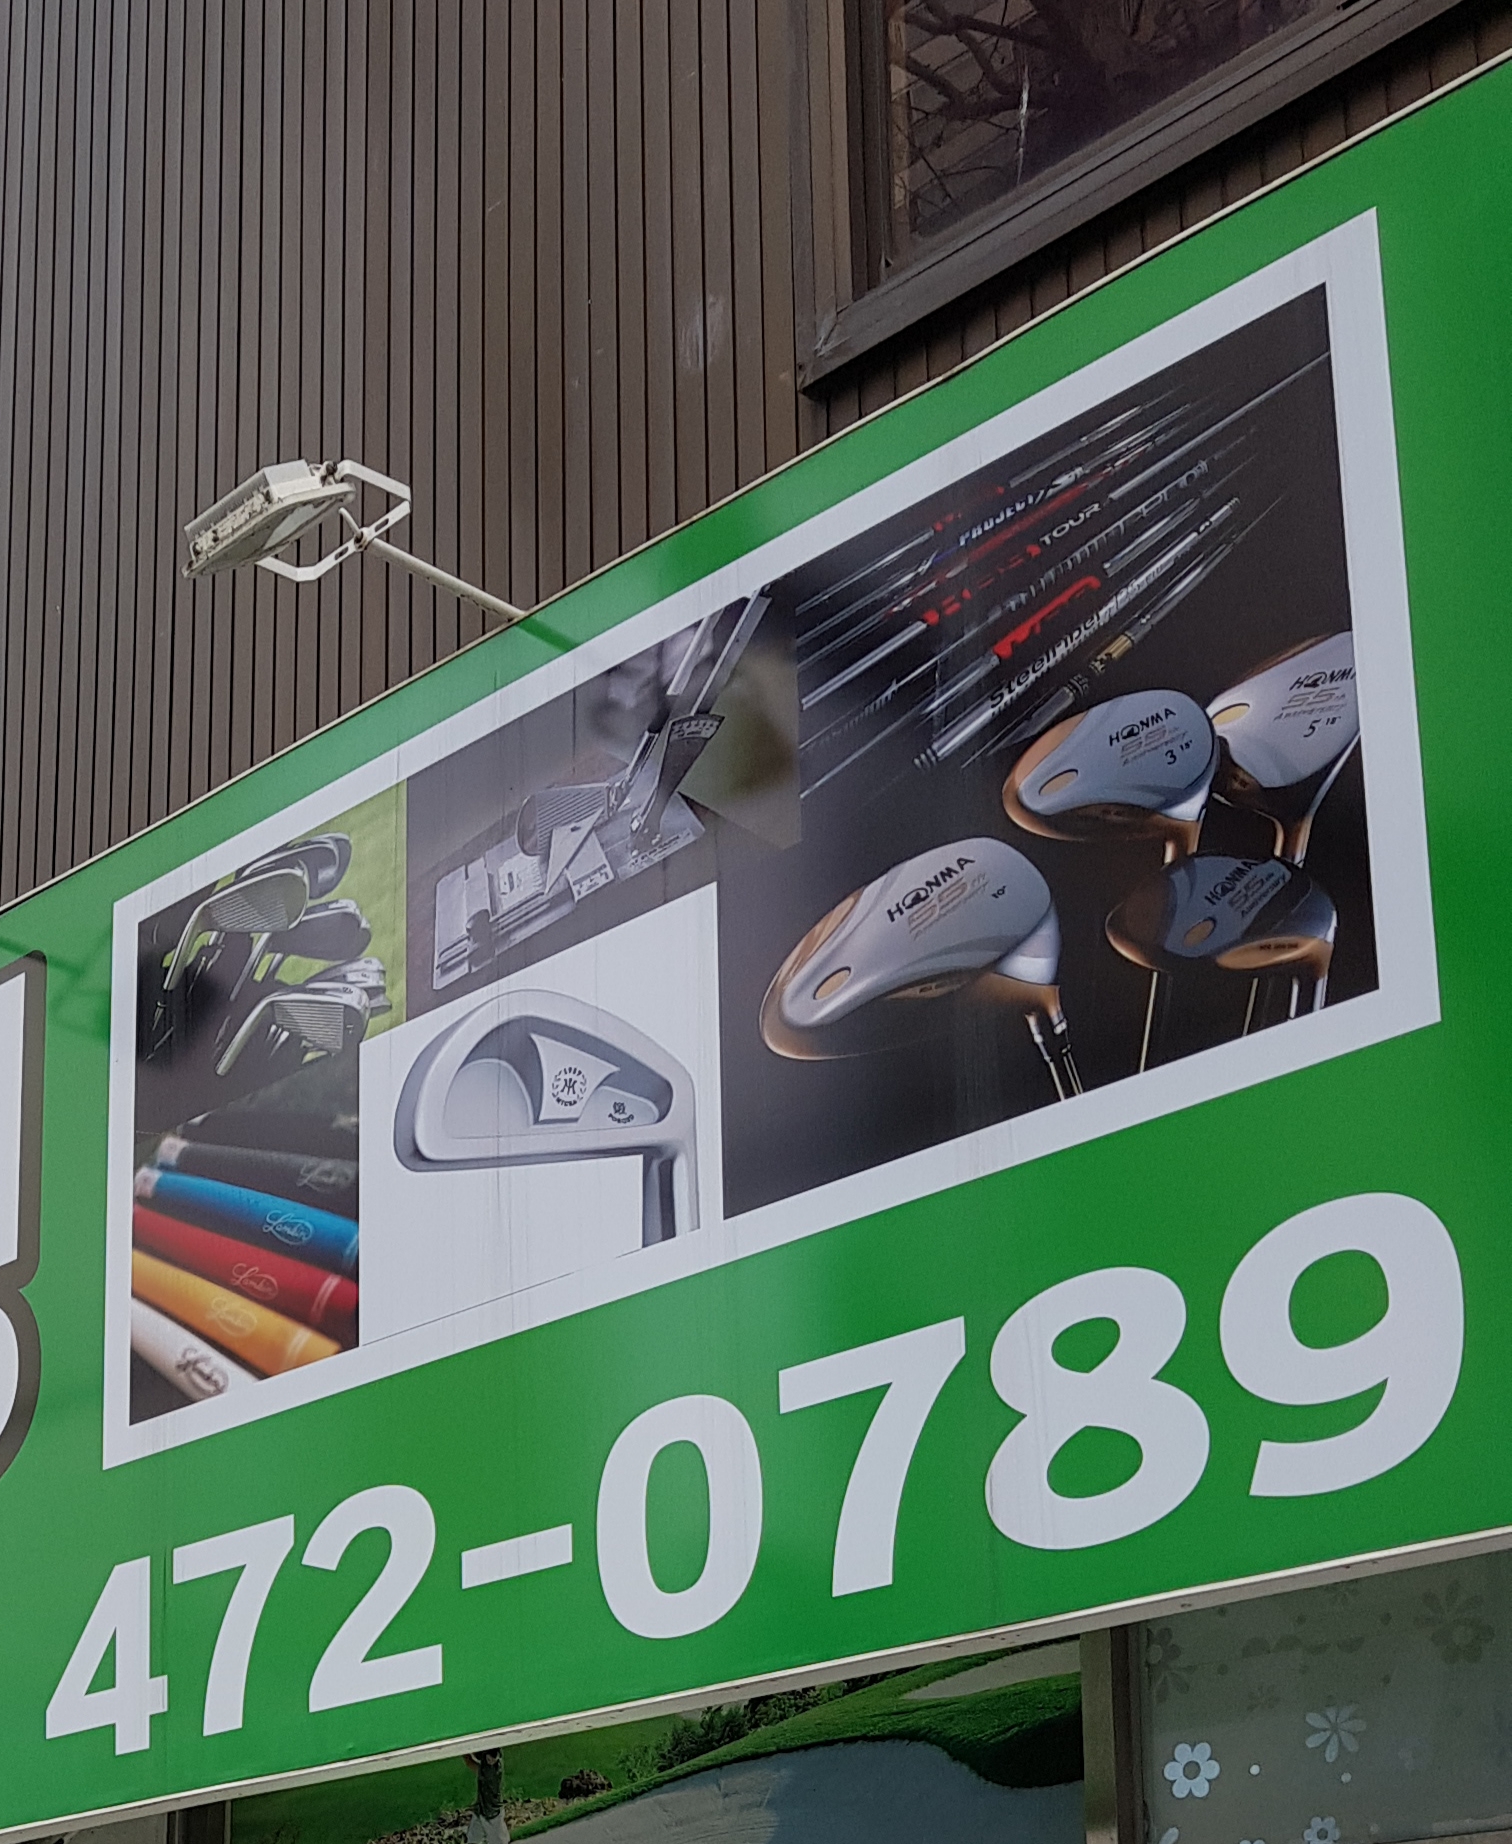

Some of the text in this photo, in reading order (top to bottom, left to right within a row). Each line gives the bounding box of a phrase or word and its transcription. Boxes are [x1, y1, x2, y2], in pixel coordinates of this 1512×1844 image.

[1040, 501, 1101, 547] TOUR
[1108, 706, 1177, 747] HONMA
[886, 857, 976, 923] HONMA
[45, 1190, 1468, 1758] 472-0789
